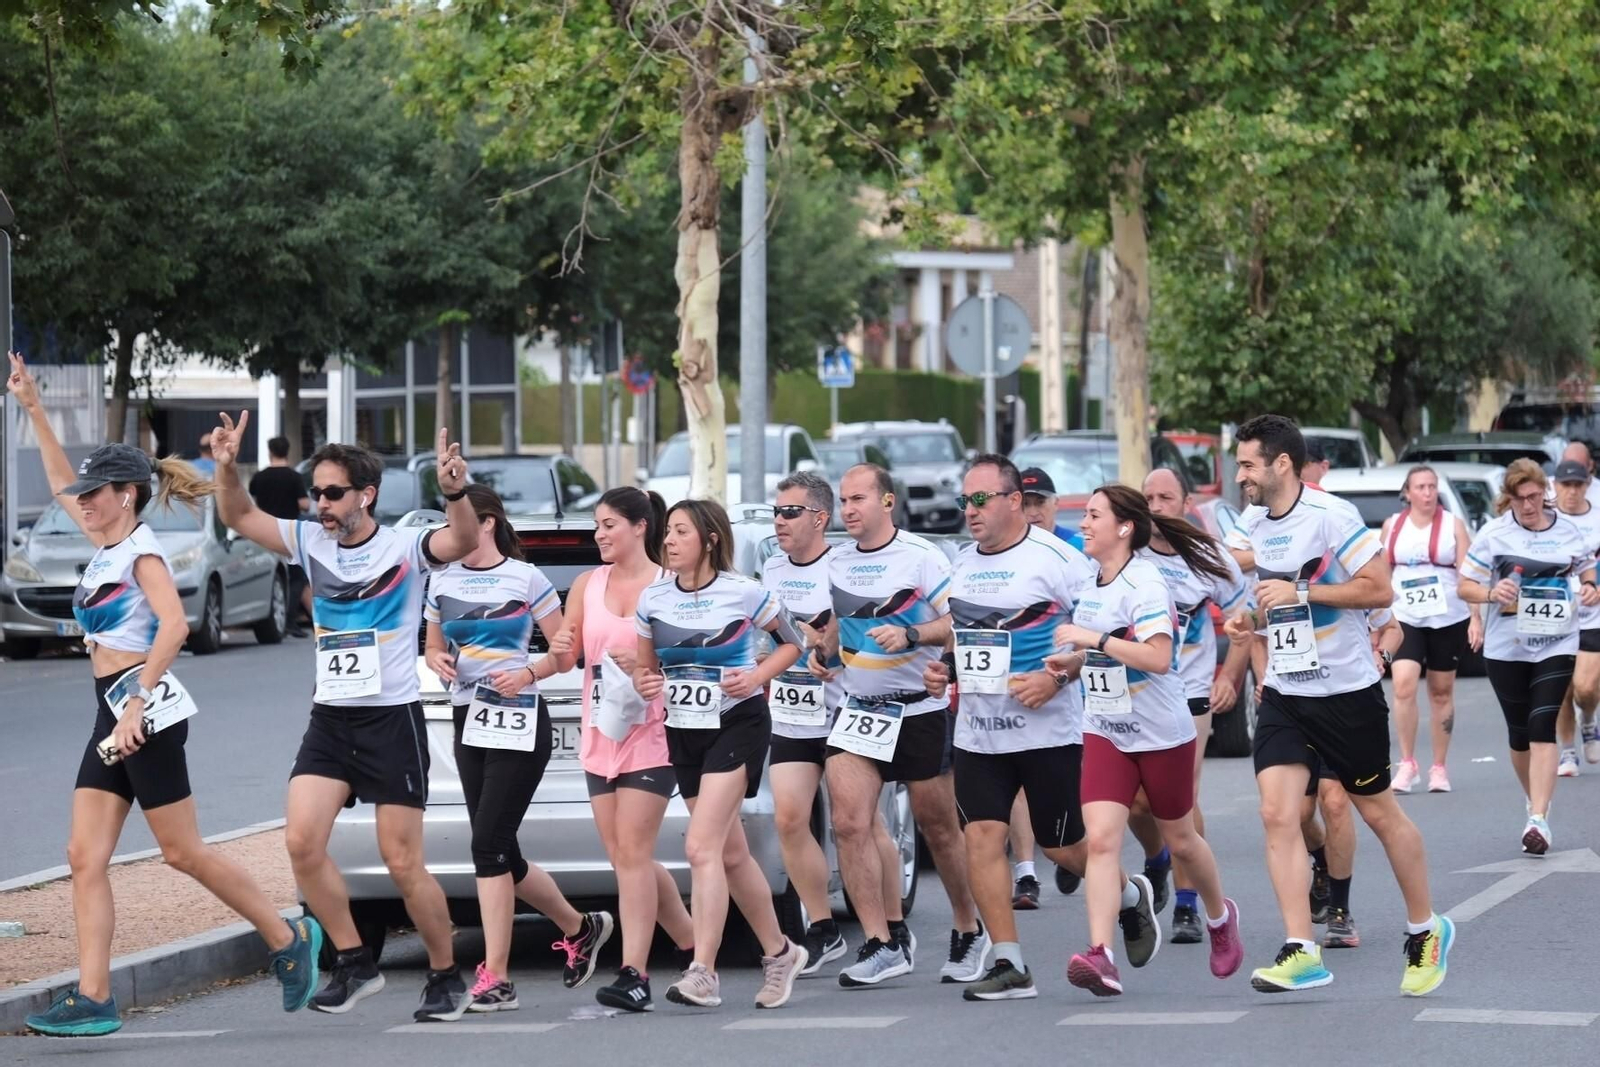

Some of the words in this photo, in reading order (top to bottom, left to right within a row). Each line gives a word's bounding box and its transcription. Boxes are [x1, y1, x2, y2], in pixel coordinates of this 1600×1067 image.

[1406, 588, 1438, 605] 524
[1525, 603, 1565, 618] 442
[1274, 627, 1297, 650] 14
[328, 653, 360, 676] 42
[964, 650, 991, 671] 13
[1088, 671, 1110, 692] 11
[668, 684, 711, 706] 220
[774, 687, 816, 706] 494
[474, 707, 527, 731] 413
[844, 714, 892, 738] 787
